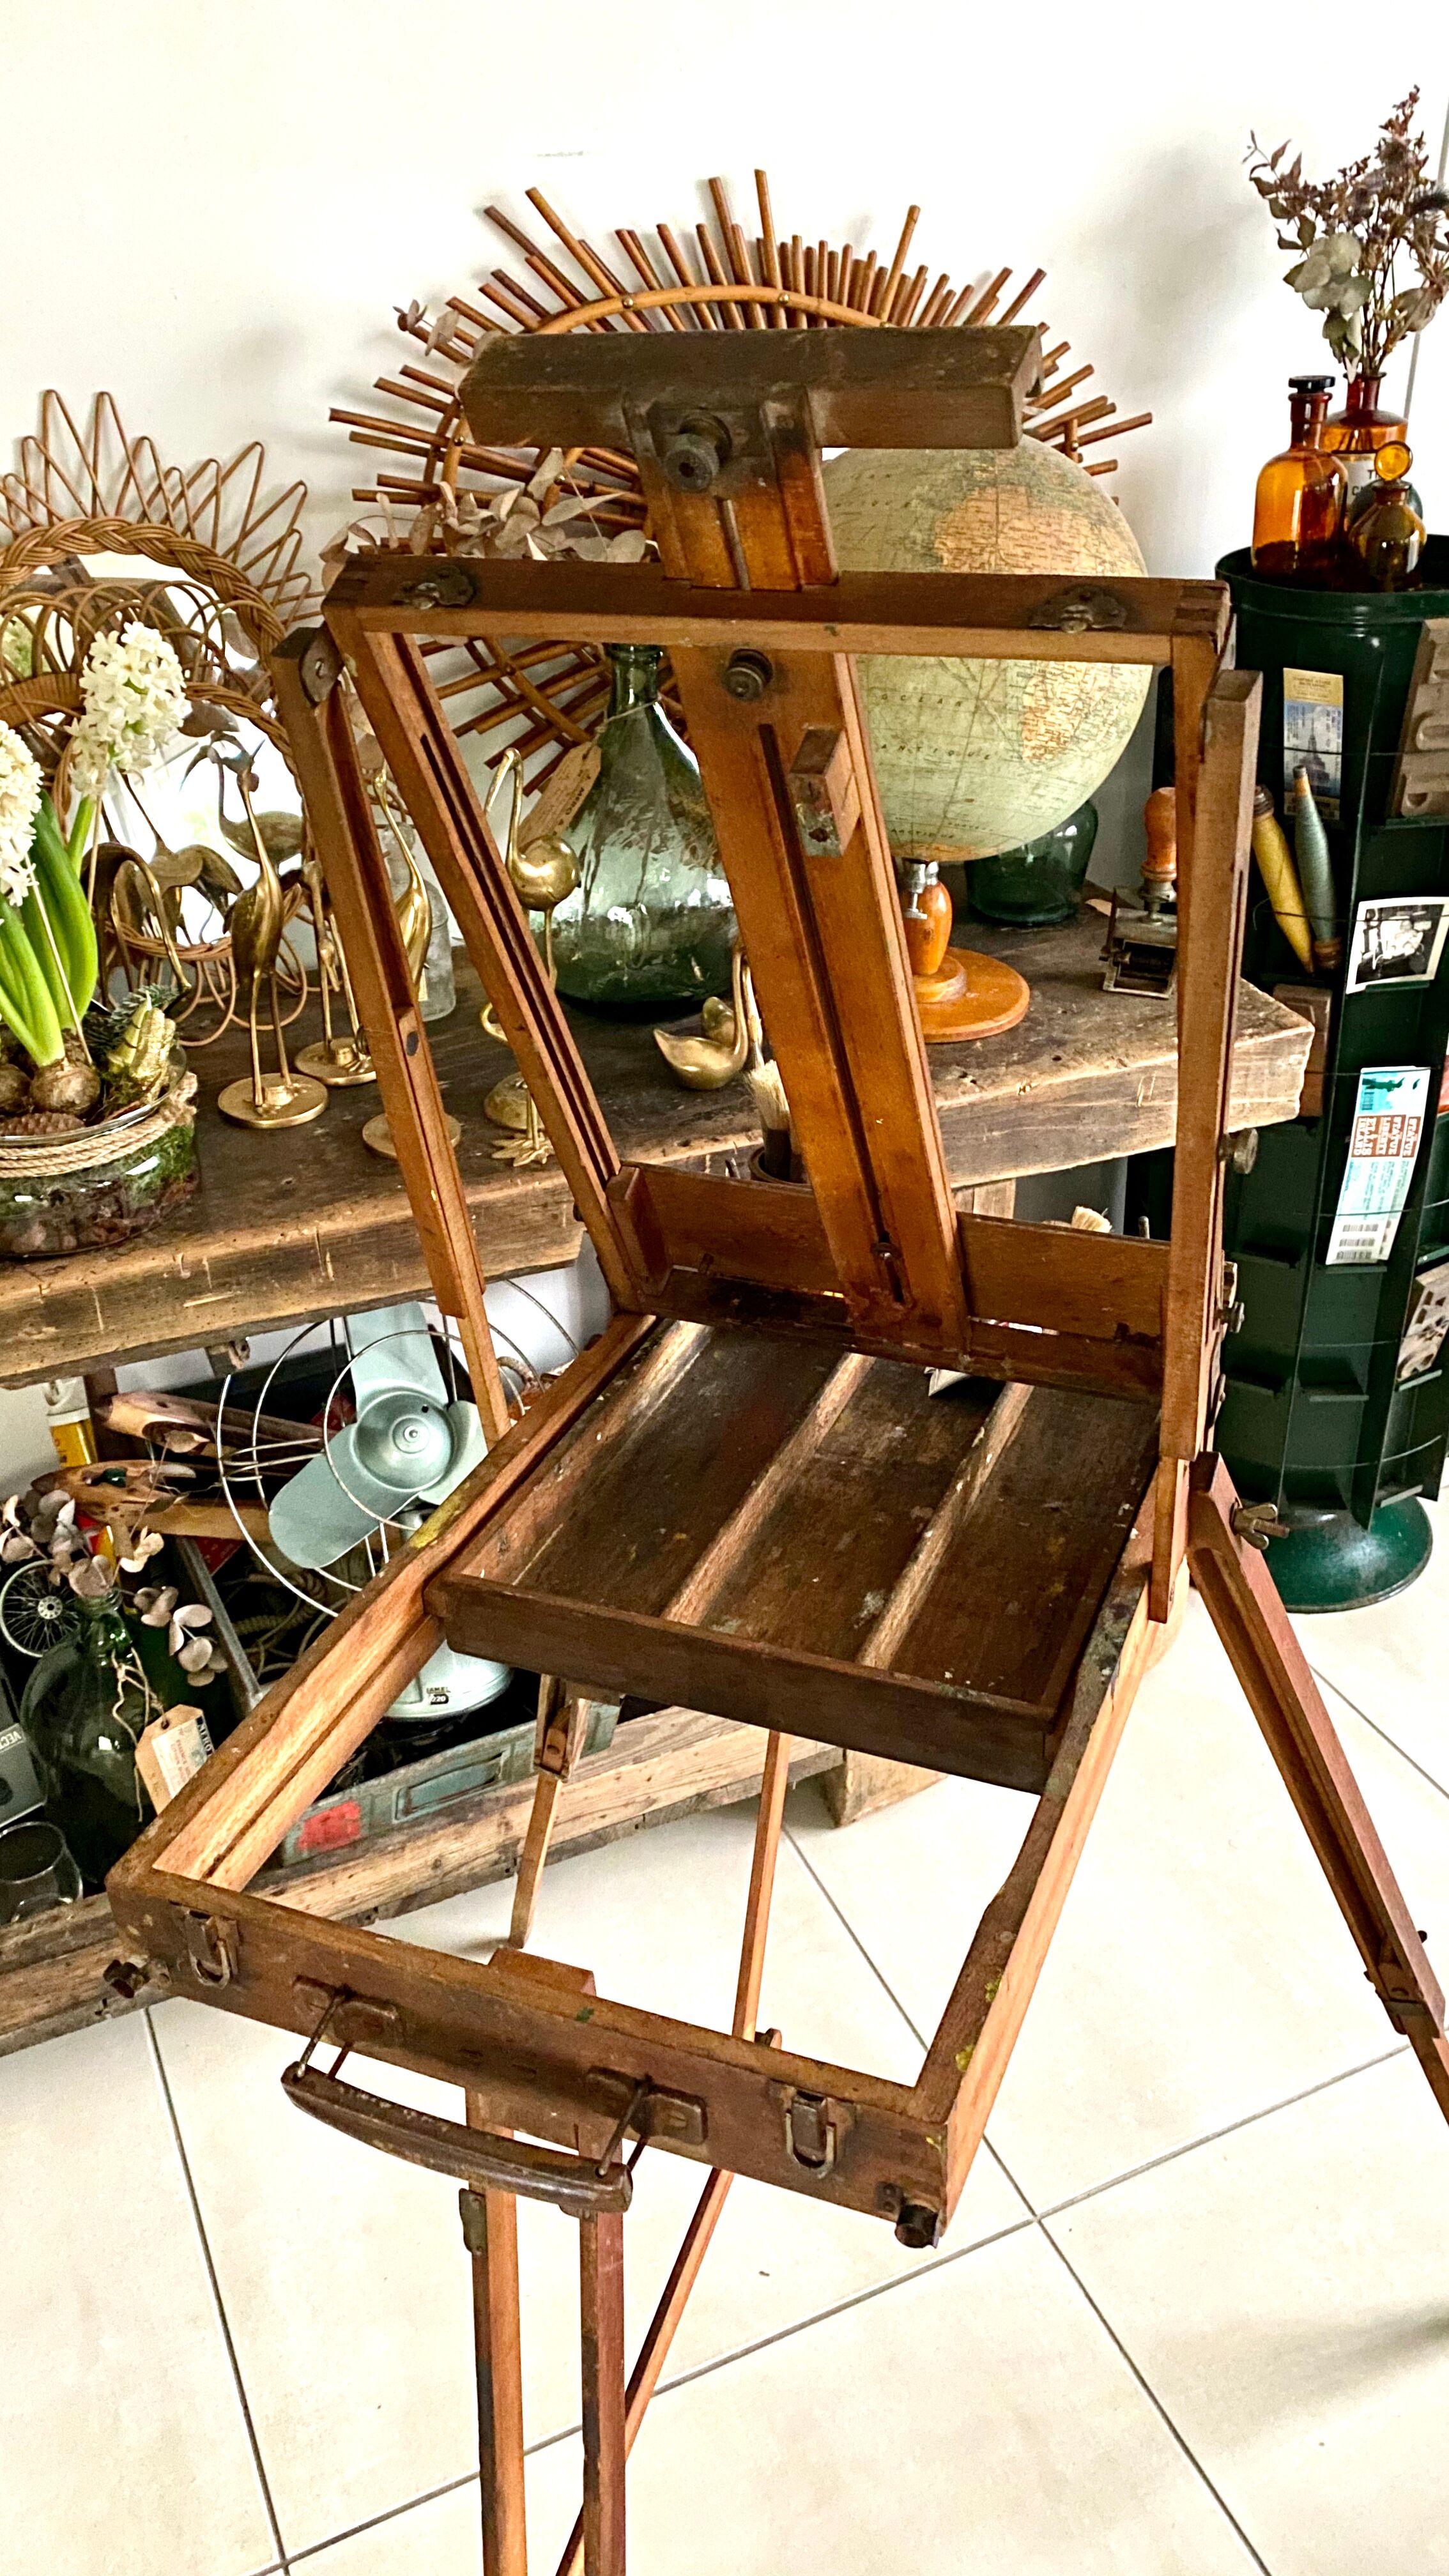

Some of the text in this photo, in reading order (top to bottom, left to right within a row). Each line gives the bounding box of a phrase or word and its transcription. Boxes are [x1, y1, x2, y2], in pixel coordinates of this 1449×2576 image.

[1353, 1117, 1367, 1156] ISLAND
[1361, 1117, 1377, 1156] ELLIS
[1379, 1117, 1392, 1155] LIBERTY
[1388, 1116, 1402, 1155] STATUE
[1403, 1117, 1418, 1156] STATUE
